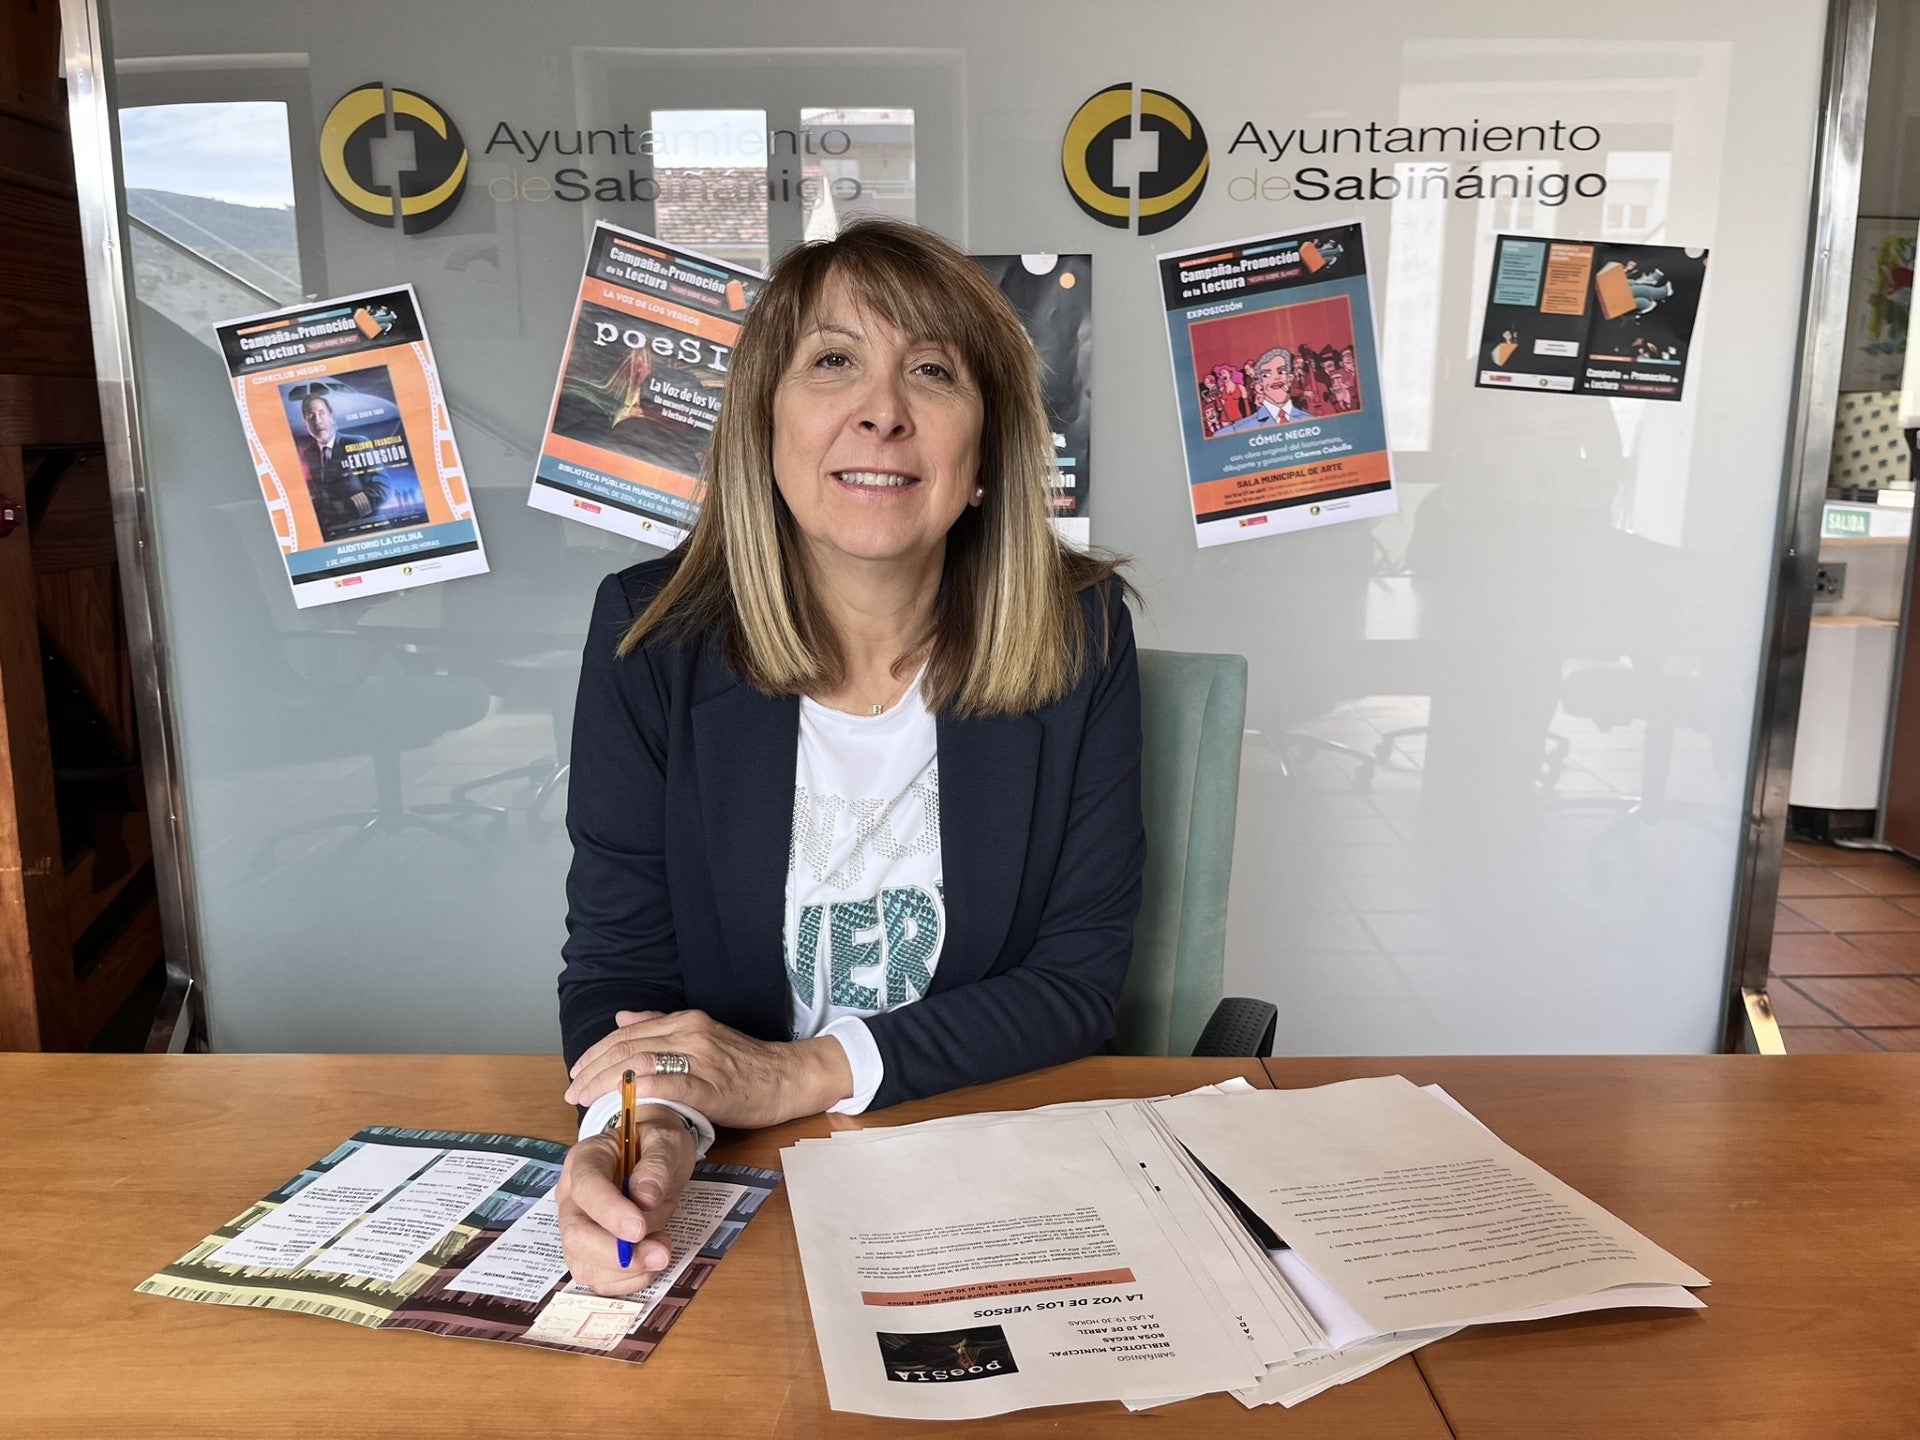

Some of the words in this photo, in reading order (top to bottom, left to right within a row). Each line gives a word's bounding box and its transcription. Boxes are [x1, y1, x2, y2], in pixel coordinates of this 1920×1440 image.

[484, 118, 852, 163] Ayuntamiento
[1227, 119, 1601, 162] Ayuntamiento
[609, 247, 660, 274] Campaña
[668, 265, 726, 294] Promoción
[1180, 263, 1231, 283] Campaña
[1240, 250, 1299, 271] Promoción
[625, 268, 667, 290] Lectura
[1202, 276, 1245, 294] Lectura
[603, 289, 614, 299] LA
[616, 293, 632, 304] VOZ
[635, 299, 646, 309] DE
[648, 303, 665, 315] LOS
[667, 309, 700, 326] VERSOS
[1186, 300, 1242, 319] EXPOSICIÓN
[239, 329, 291, 350] Campaña
[297, 316, 356, 338] Promoción
[262, 342, 306, 360] Lectura
[592, 321, 729, 372] poeSI
[251, 370, 295, 385] CINECLUB
[295, 364, 326, 376] NEGRO
[649, 378, 661, 392] La
[662, 382, 679, 398] Voz
[680, 387, 692, 401] de
[692, 391, 707, 406] los
[1248, 431, 1282, 447] CÓMIC
[1285, 425, 1320, 440] NEGRO
[347, 443, 406, 469] EXTORSIÓN
[558, 463, 600, 481] BIBLIOTECA
[601, 475, 630, 491] PÚBLICA
[632, 486, 669, 503] MUNICIPAL
[1237, 477, 1259, 488] SALA
[1261, 469, 1304, 484] MUNICIPAL
[1307, 467, 1317, 475] DE
[1320, 463, 1342, 473] ARTE
[1827, 511, 1866, 534] SALIDA
[336, 539, 380, 555] AUDITORIO
[379, 537, 392, 546] LA
[392, 531, 422, 543] COLINA
[1021, 1284, 1063, 1294] Promoción
[1029, 1276, 1073, 1284] Sabiñánigo
[1076, 1279, 1113, 1288] Campaña
[941, 1295, 966, 1303] Negro
[967, 1291, 998, 1299] Lectura
[1092, 1296, 1122, 1305] VOZ
[1125, 1294, 1143, 1302] LA
[973, 1305, 1032, 1318] VERSOS
[1036, 1301, 1064, 1311] LOS
[1101, 1316, 1127, 1324] 19:30
[1141, 1323, 1160, 1331] DÍA
[1137, 1332, 1165, 1340] ROSA
[1048, 1347, 1107, 1357] MUNICIPAL
[1110, 1342, 1170, 1352] BIBLIOTECA
[1116, 1351, 1175, 1362] SABIÑÁNIGO
